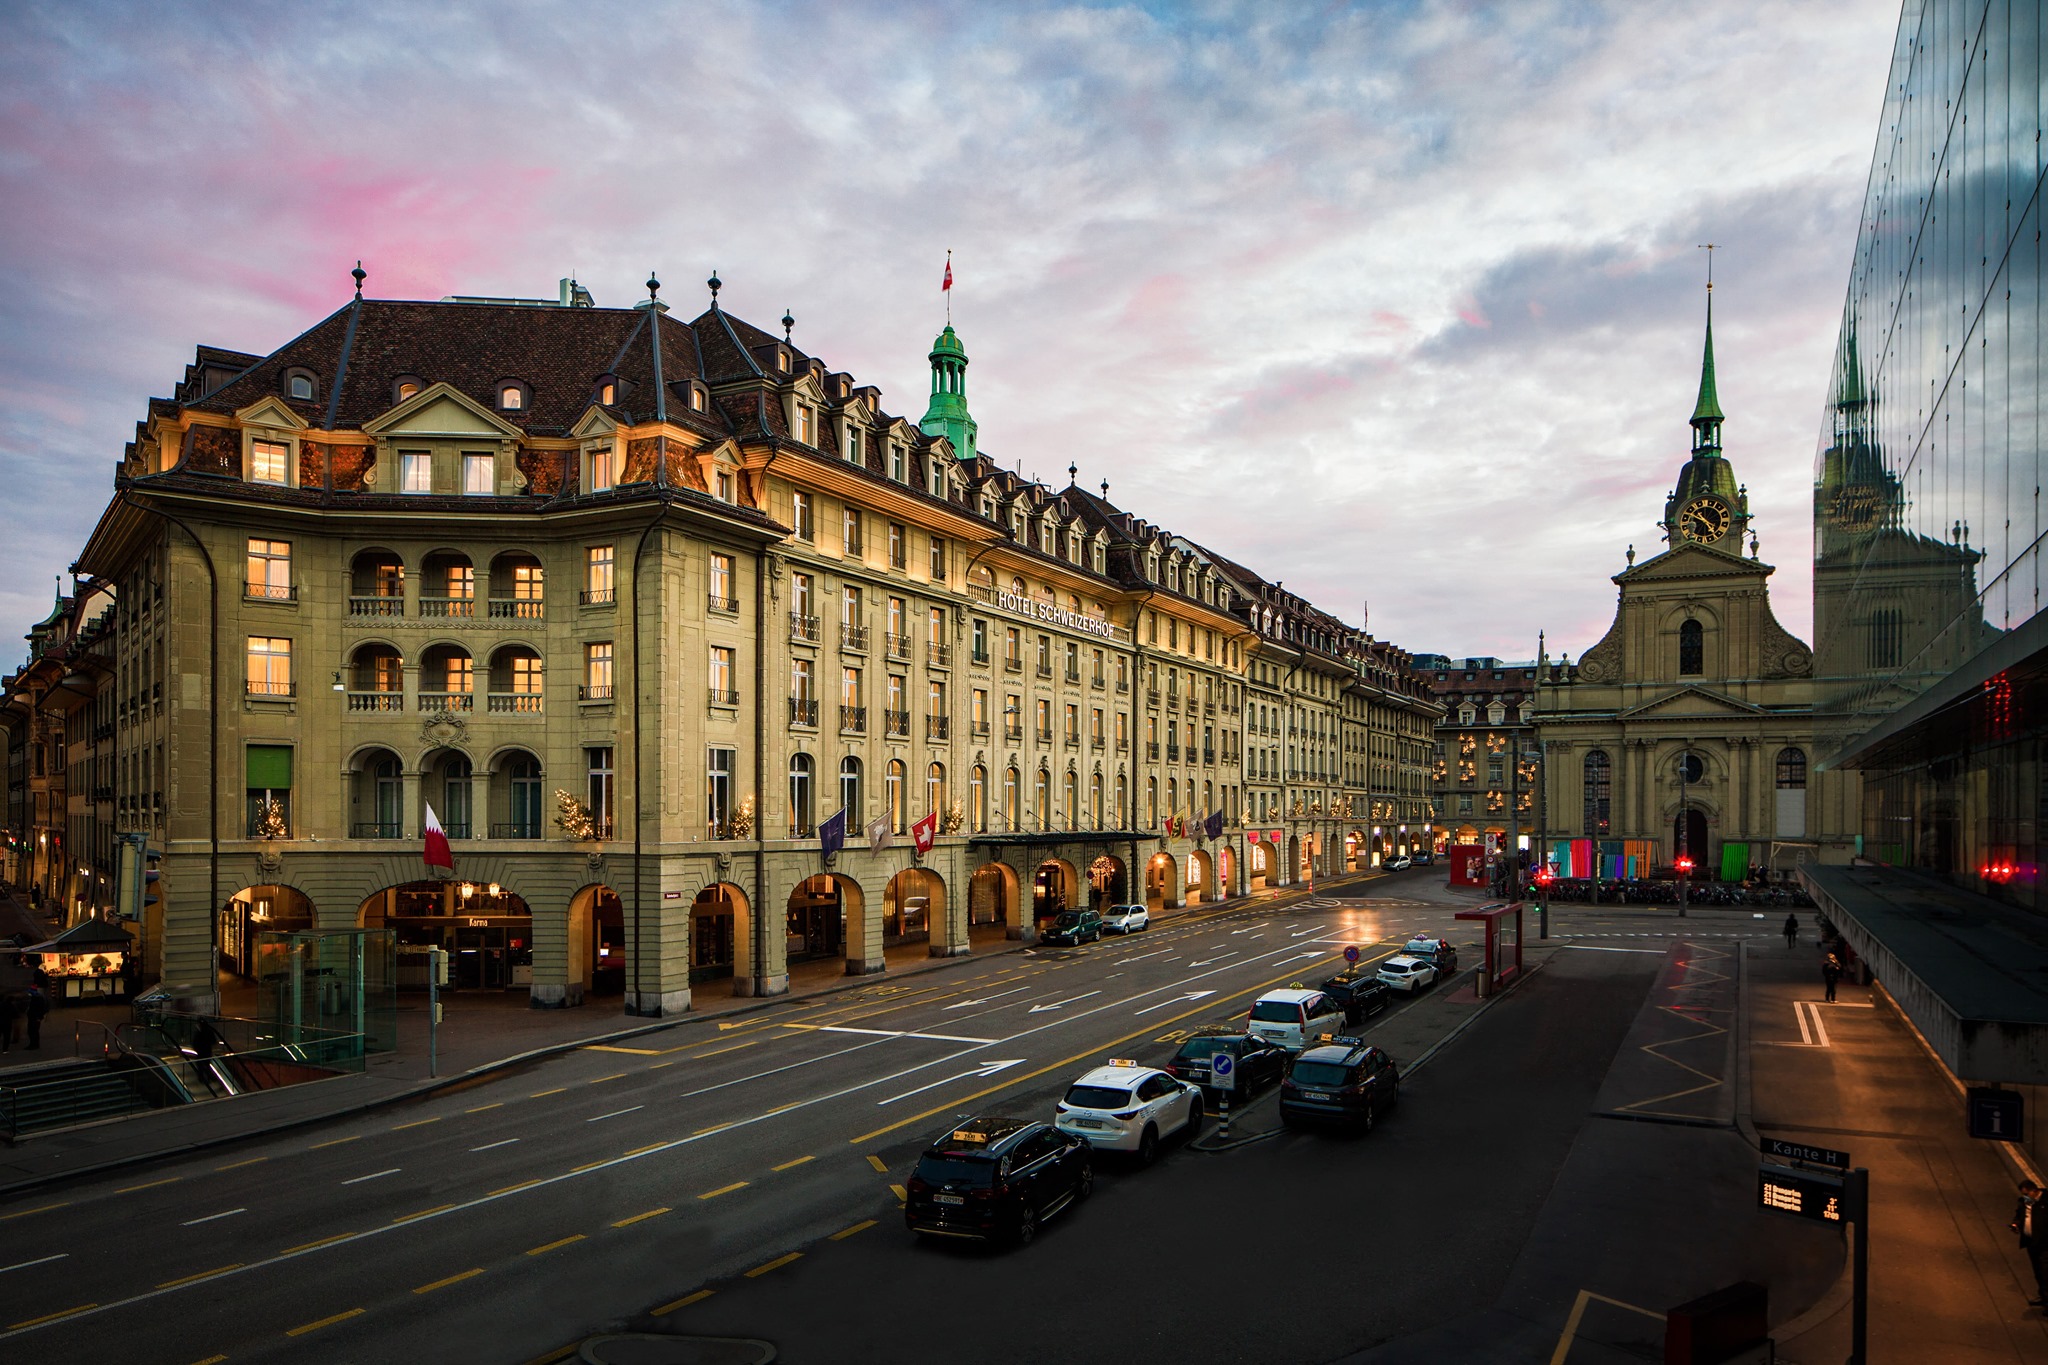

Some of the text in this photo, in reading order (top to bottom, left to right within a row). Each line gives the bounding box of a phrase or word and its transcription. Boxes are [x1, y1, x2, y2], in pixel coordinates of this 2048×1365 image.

[998, 590, 1115, 638] HOTEL SCHWEIZERHOF
[469, 918, 488, 927] Karma
[1773, 1141, 1837, 1163] Kante H
[1764, 1183, 1772, 1191] 21
[1764, 1190, 1772, 1198] 21
[1764, 1197, 1772, 1205] 21
